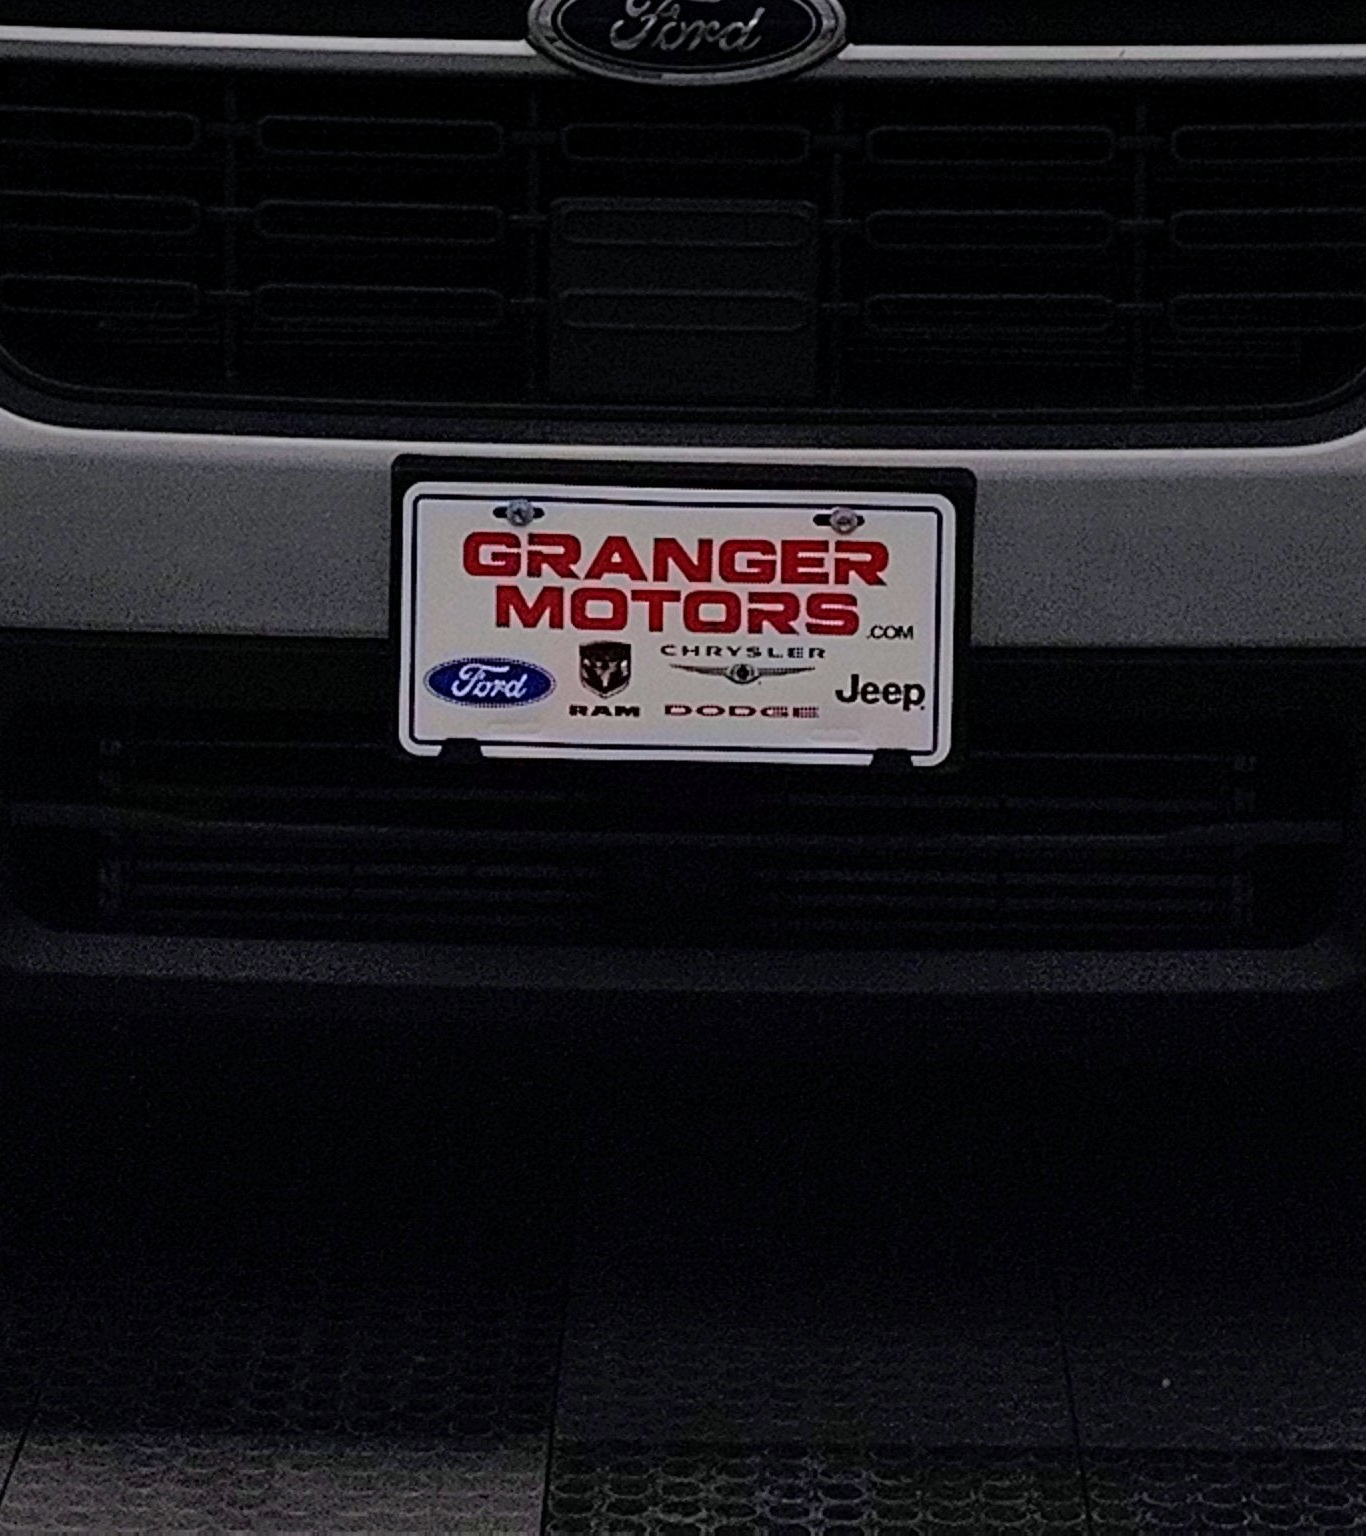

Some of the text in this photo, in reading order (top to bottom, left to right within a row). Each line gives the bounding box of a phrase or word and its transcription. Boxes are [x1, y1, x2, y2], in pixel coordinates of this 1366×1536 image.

[463, 531, 889, 586] GRANGER
[495, 585, 914, 640] MOTORS .COM
[660, 644, 826, 659] CHRYSLER
[450, 663, 528, 698] Ford
[835, 673, 926, 712] Jeep
[569, 704, 641, 718] RAM
[664, 704, 820, 719] DODGE
